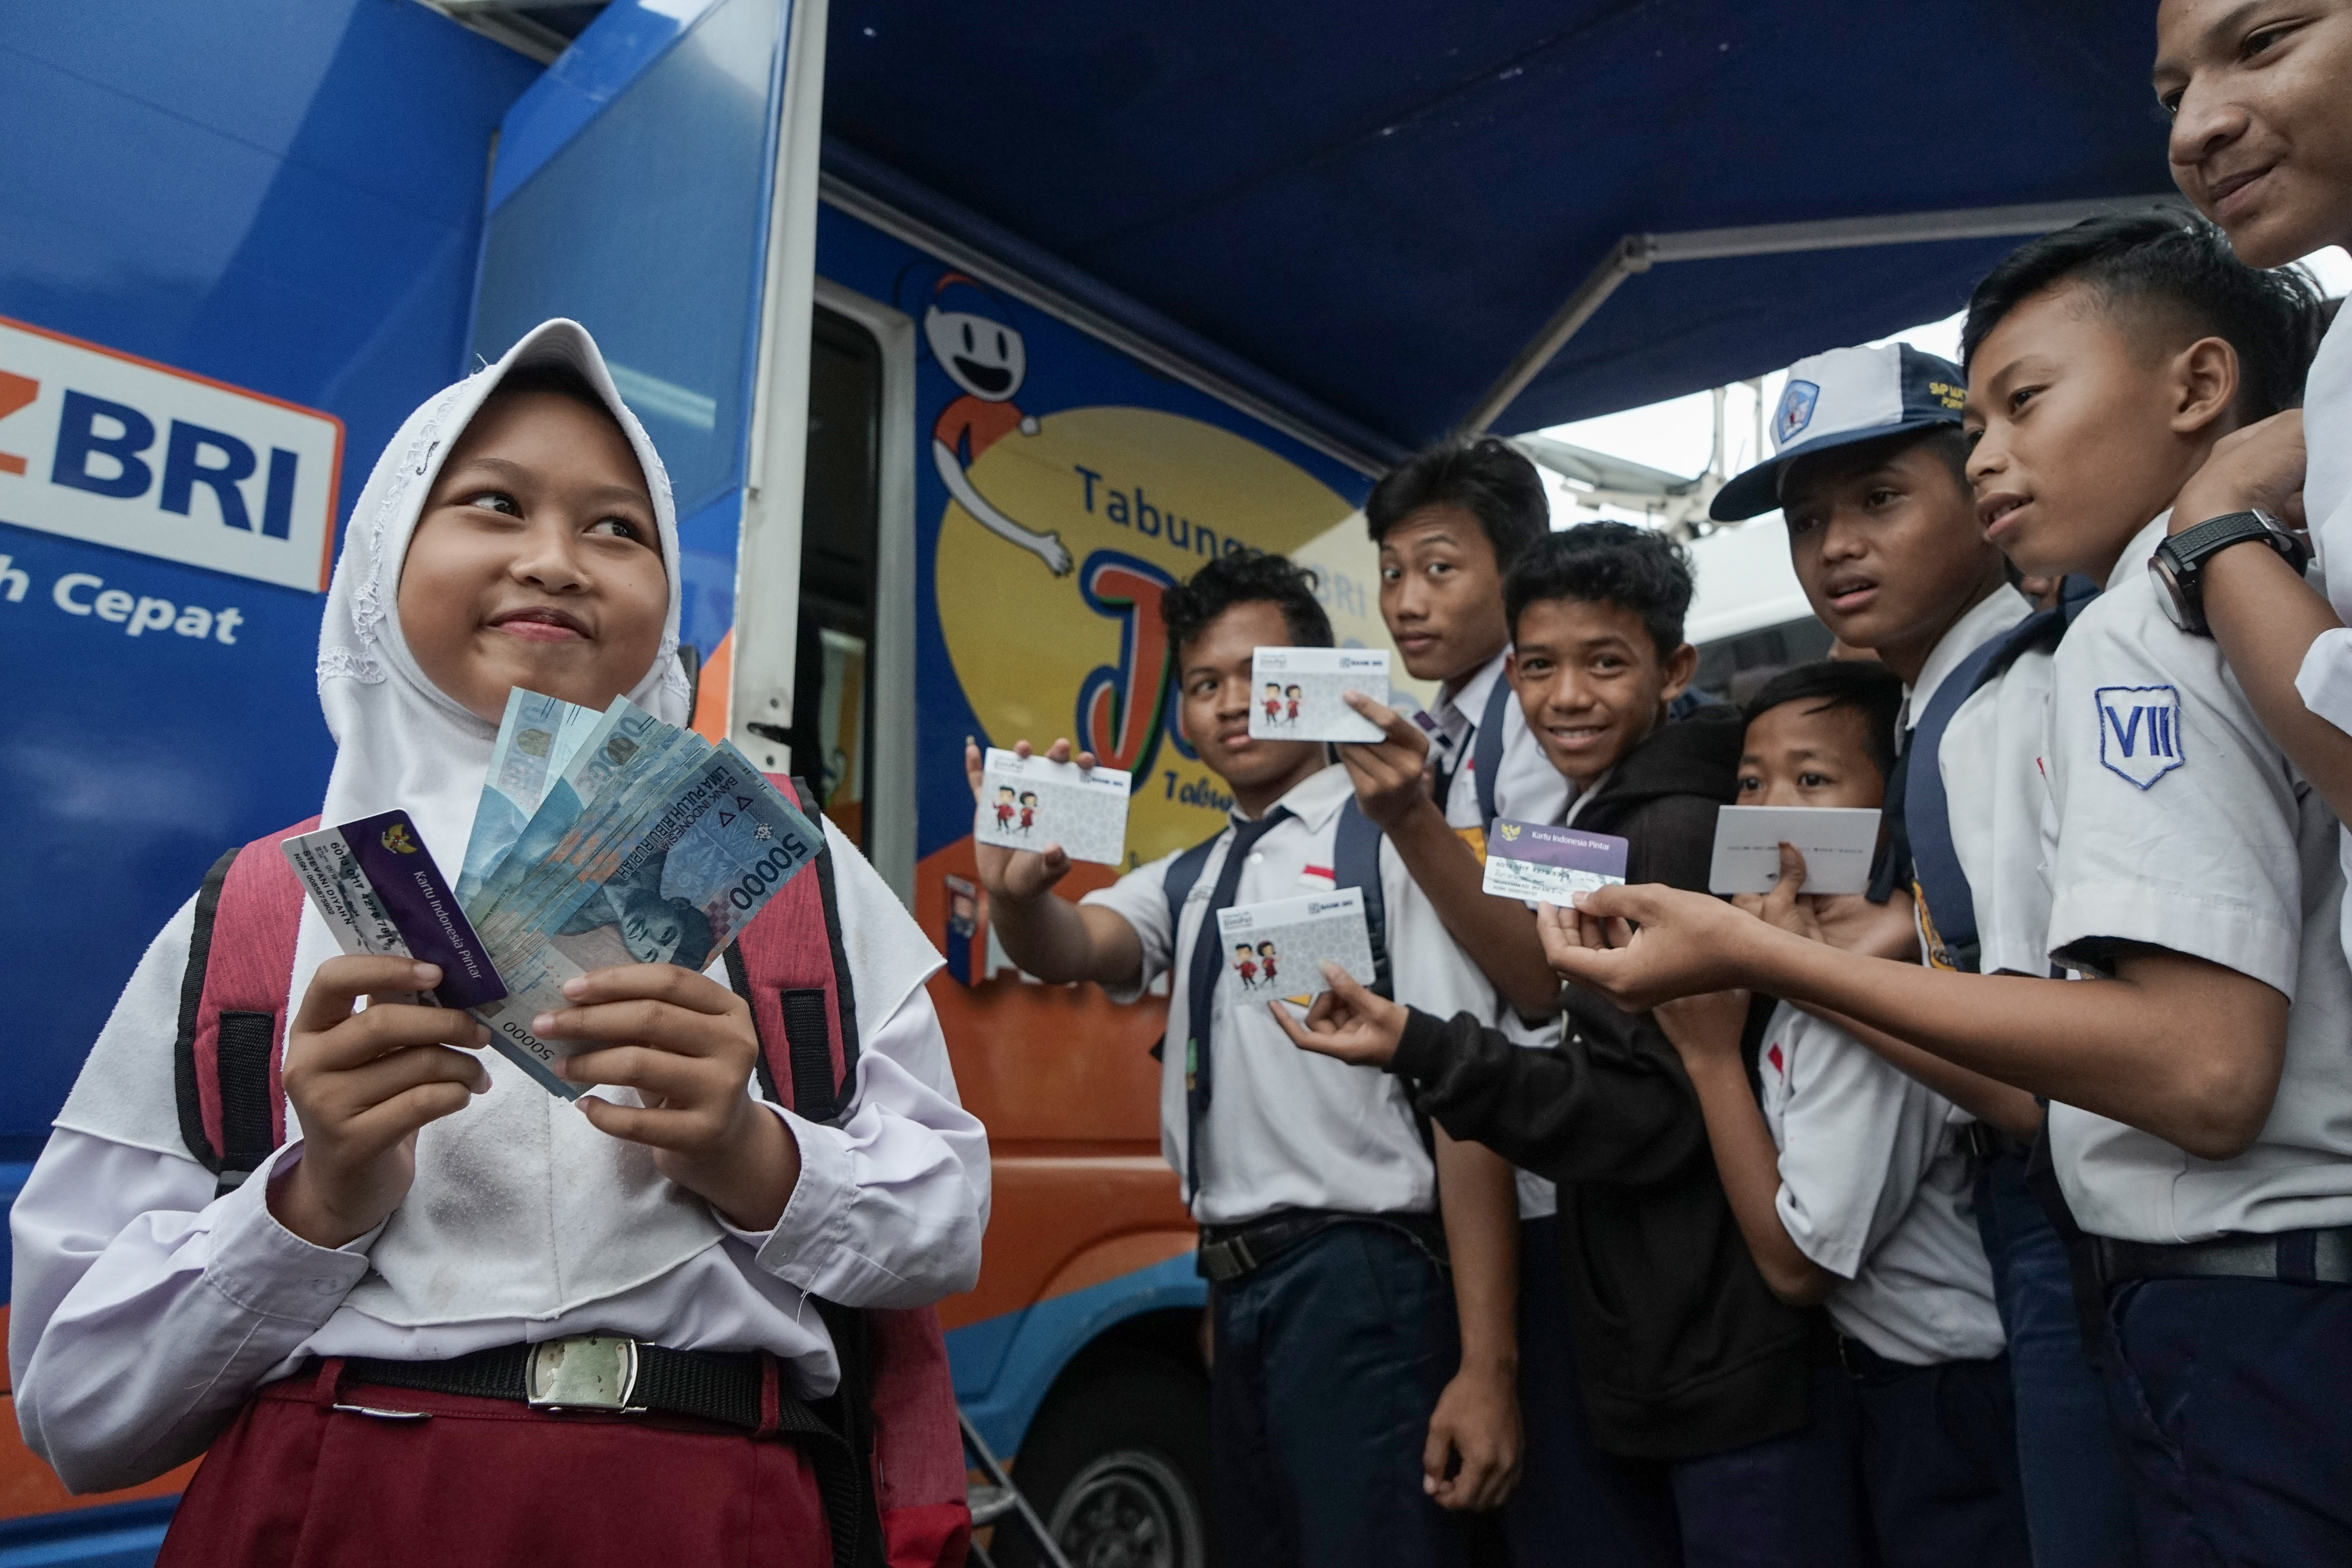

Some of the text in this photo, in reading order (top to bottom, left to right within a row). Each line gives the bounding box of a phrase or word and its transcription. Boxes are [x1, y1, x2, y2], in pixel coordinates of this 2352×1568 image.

[51, 388, 299, 541] BRI
[53, 572, 244, 645] Cepat
[2105, 706, 2173, 758] VII
[617, 765, 730, 880] LIMA PULUH RIBU RUPIAH
[659, 776, 739, 852] BANK INDONESIA
[1532, 831, 1610, 851] Kartu Indonesia Pintar
[293, 853, 309, 871] NISN
[303, 850, 330, 888] STEVANI
[326, 889, 348, 917] DIYAH
[330, 842, 349, 867] 6013
[346, 868, 365, 889] 0117
[729, 833, 808, 910] 50000
[413, 871, 482, 979] Kartu Indonesia Pintar
[503, 1021, 555, 1061] 50000
